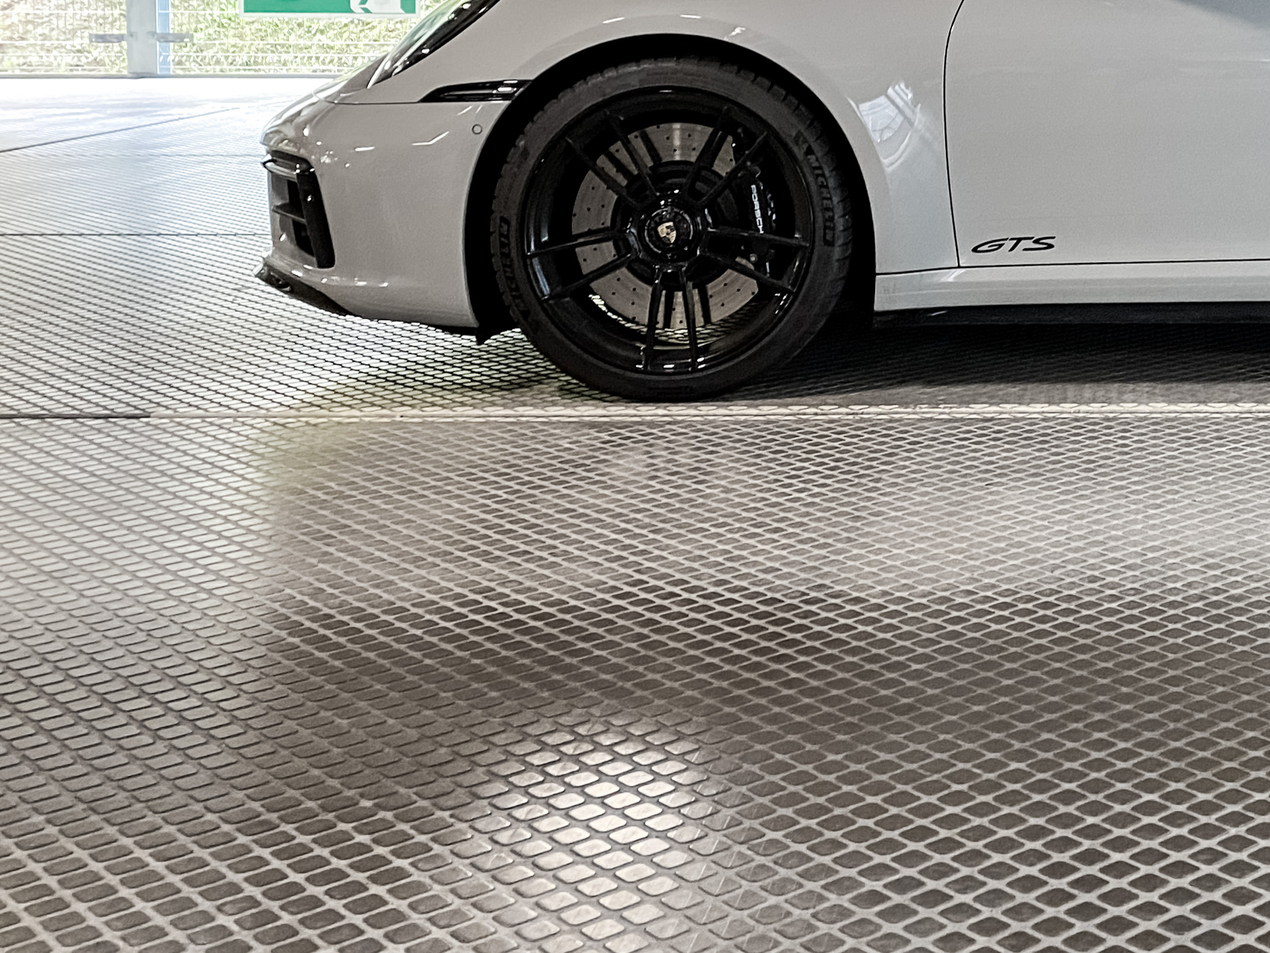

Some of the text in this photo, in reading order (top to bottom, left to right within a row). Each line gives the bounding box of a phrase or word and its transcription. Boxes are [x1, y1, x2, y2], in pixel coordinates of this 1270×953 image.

[750, 184, 765, 235] PORSCH
[806, 155, 835, 241] MICHELIN
[971, 235, 1056, 254] GTS
